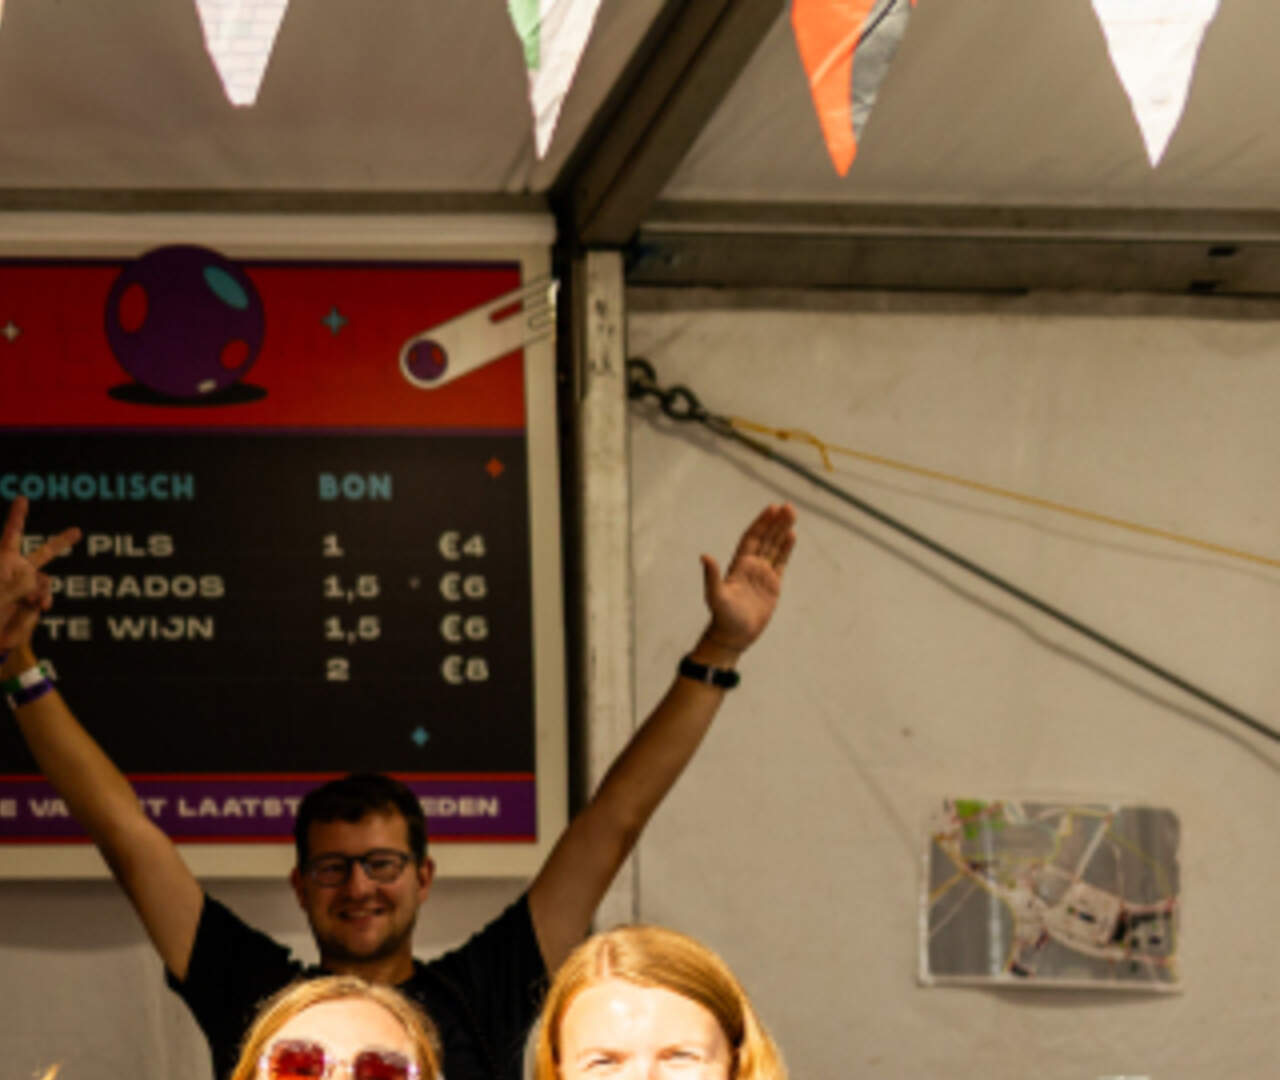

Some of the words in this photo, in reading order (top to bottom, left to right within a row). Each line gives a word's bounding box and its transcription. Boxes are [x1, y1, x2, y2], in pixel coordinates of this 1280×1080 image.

[318, 474, 392, 501] BON
[86, 532, 175, 558] PILS
[322, 535, 344, 557] 1
[438, 532, 486, 559] €4
[47, 573, 226, 600] PERADOS
[323, 576, 380, 603] 1,5
[438, 573, 488, 600] €6
[106, 615, 215, 642] WIJN
[324, 617, 381, 644] 1,5
[439, 615, 489, 642] €6
[327, 659, 349, 683] 2
[441, 656, 490, 684] €8
[30, 797, 68, 818] VA
[179, 796, 300, 818] LAATST
